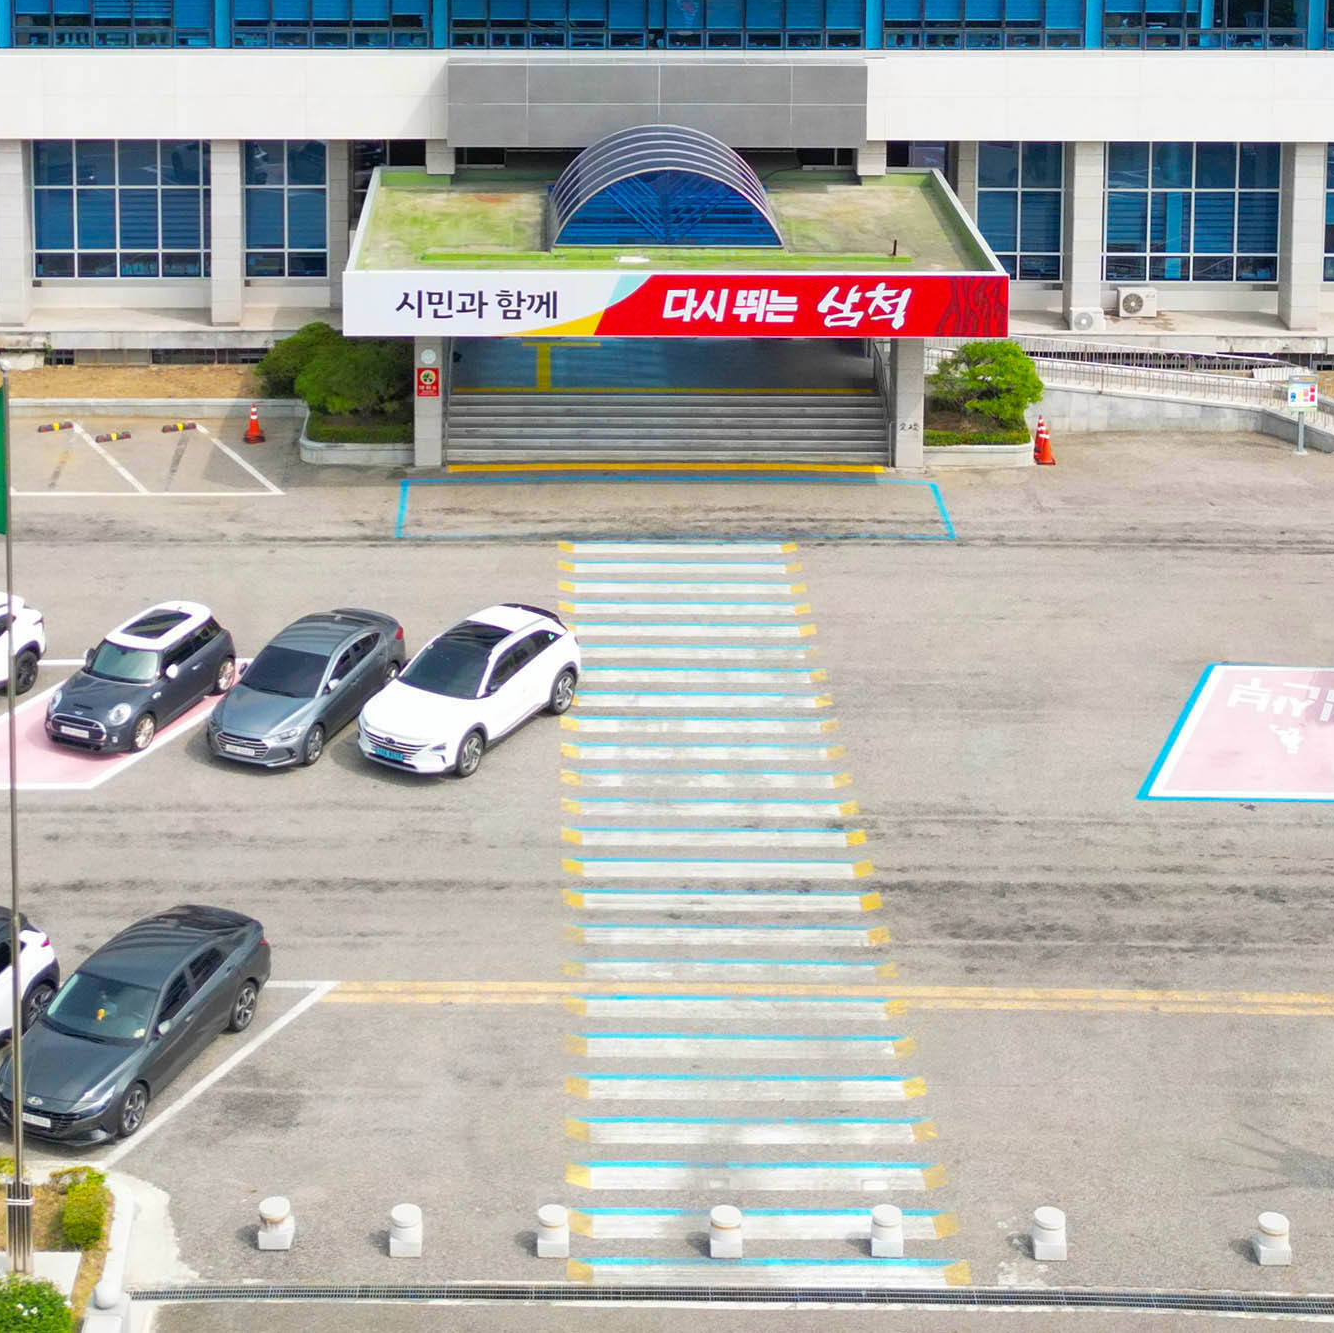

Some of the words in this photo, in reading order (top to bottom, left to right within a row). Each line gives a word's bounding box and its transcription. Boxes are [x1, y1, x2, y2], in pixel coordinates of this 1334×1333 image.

[395, 290, 489, 319] 시민과
[495, 290, 558, 320] 함께
[662, 288, 729, 323] 다시
[732, 288, 799, 323] 뛰는
[817, 282, 912, 330] 삼척
